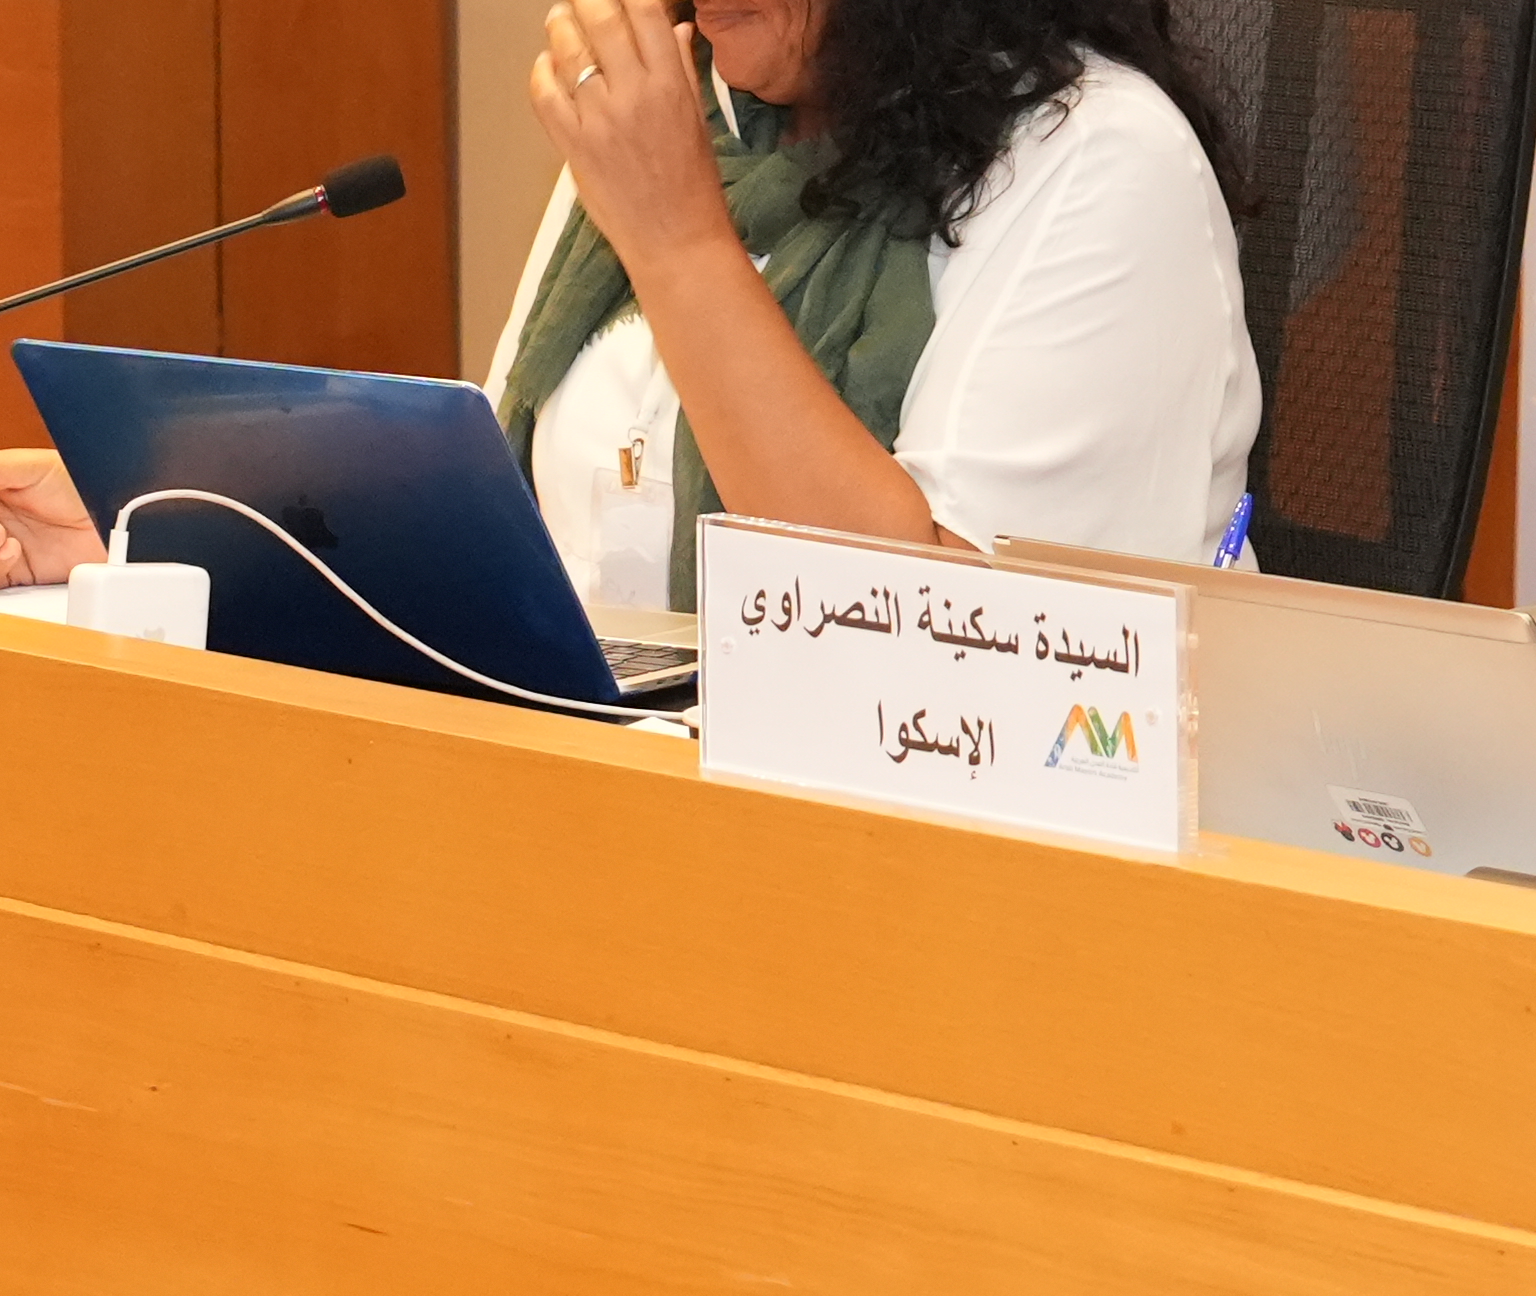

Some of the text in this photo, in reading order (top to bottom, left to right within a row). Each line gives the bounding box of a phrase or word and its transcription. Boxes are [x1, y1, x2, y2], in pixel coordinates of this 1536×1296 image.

[741, 576, 1140, 682] السيدة سكينة النصراوي
[877, 701, 995, 780] الإسكوا
